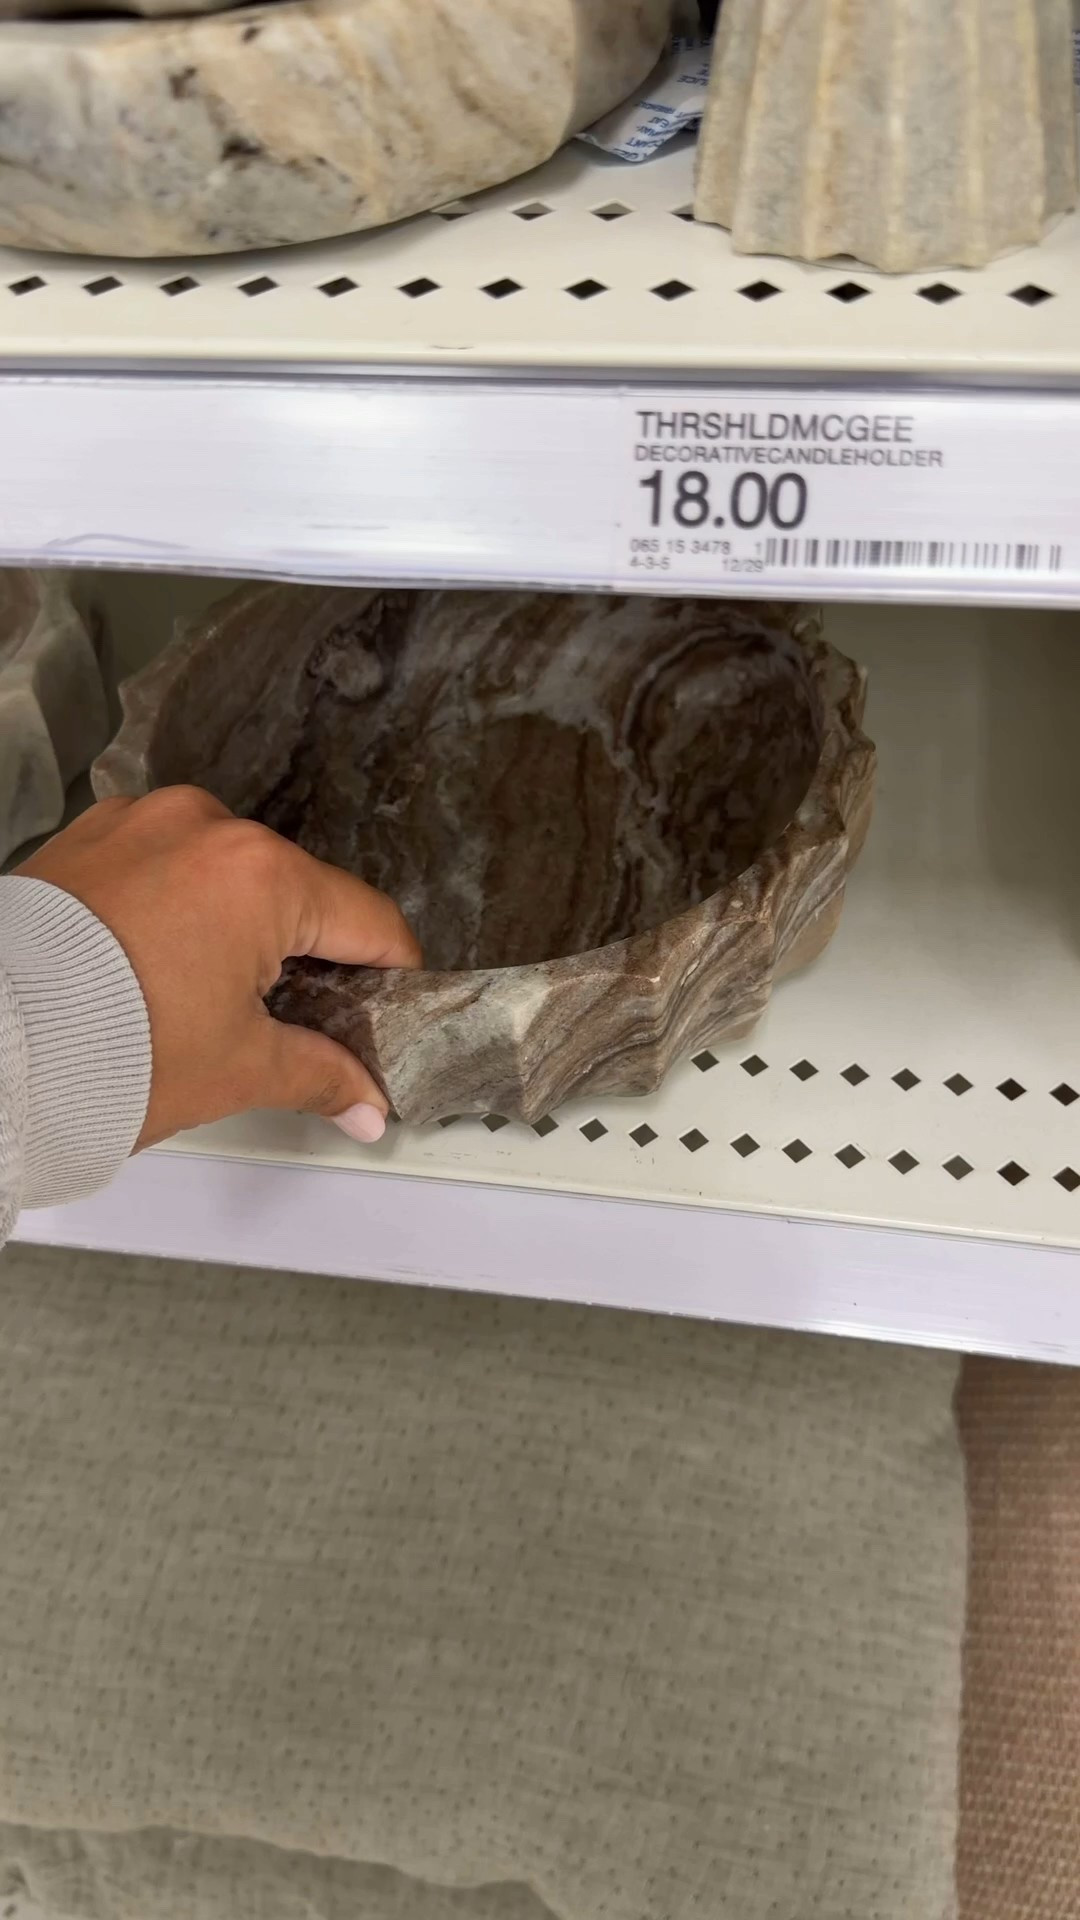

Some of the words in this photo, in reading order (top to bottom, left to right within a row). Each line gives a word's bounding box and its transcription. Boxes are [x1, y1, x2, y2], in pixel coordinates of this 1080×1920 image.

[636, 411, 914, 442] THRSHLDMCGEE
[634, 445, 943, 467] DECORATIVECANDLEHOLDER
[640, 469, 807, 530] 18.00
[630, 539, 660, 553] 065
[667, 540, 687, 554] 15
[690, 541, 731, 555] 3478
[630, 555, 670, 570] 4-3-5
